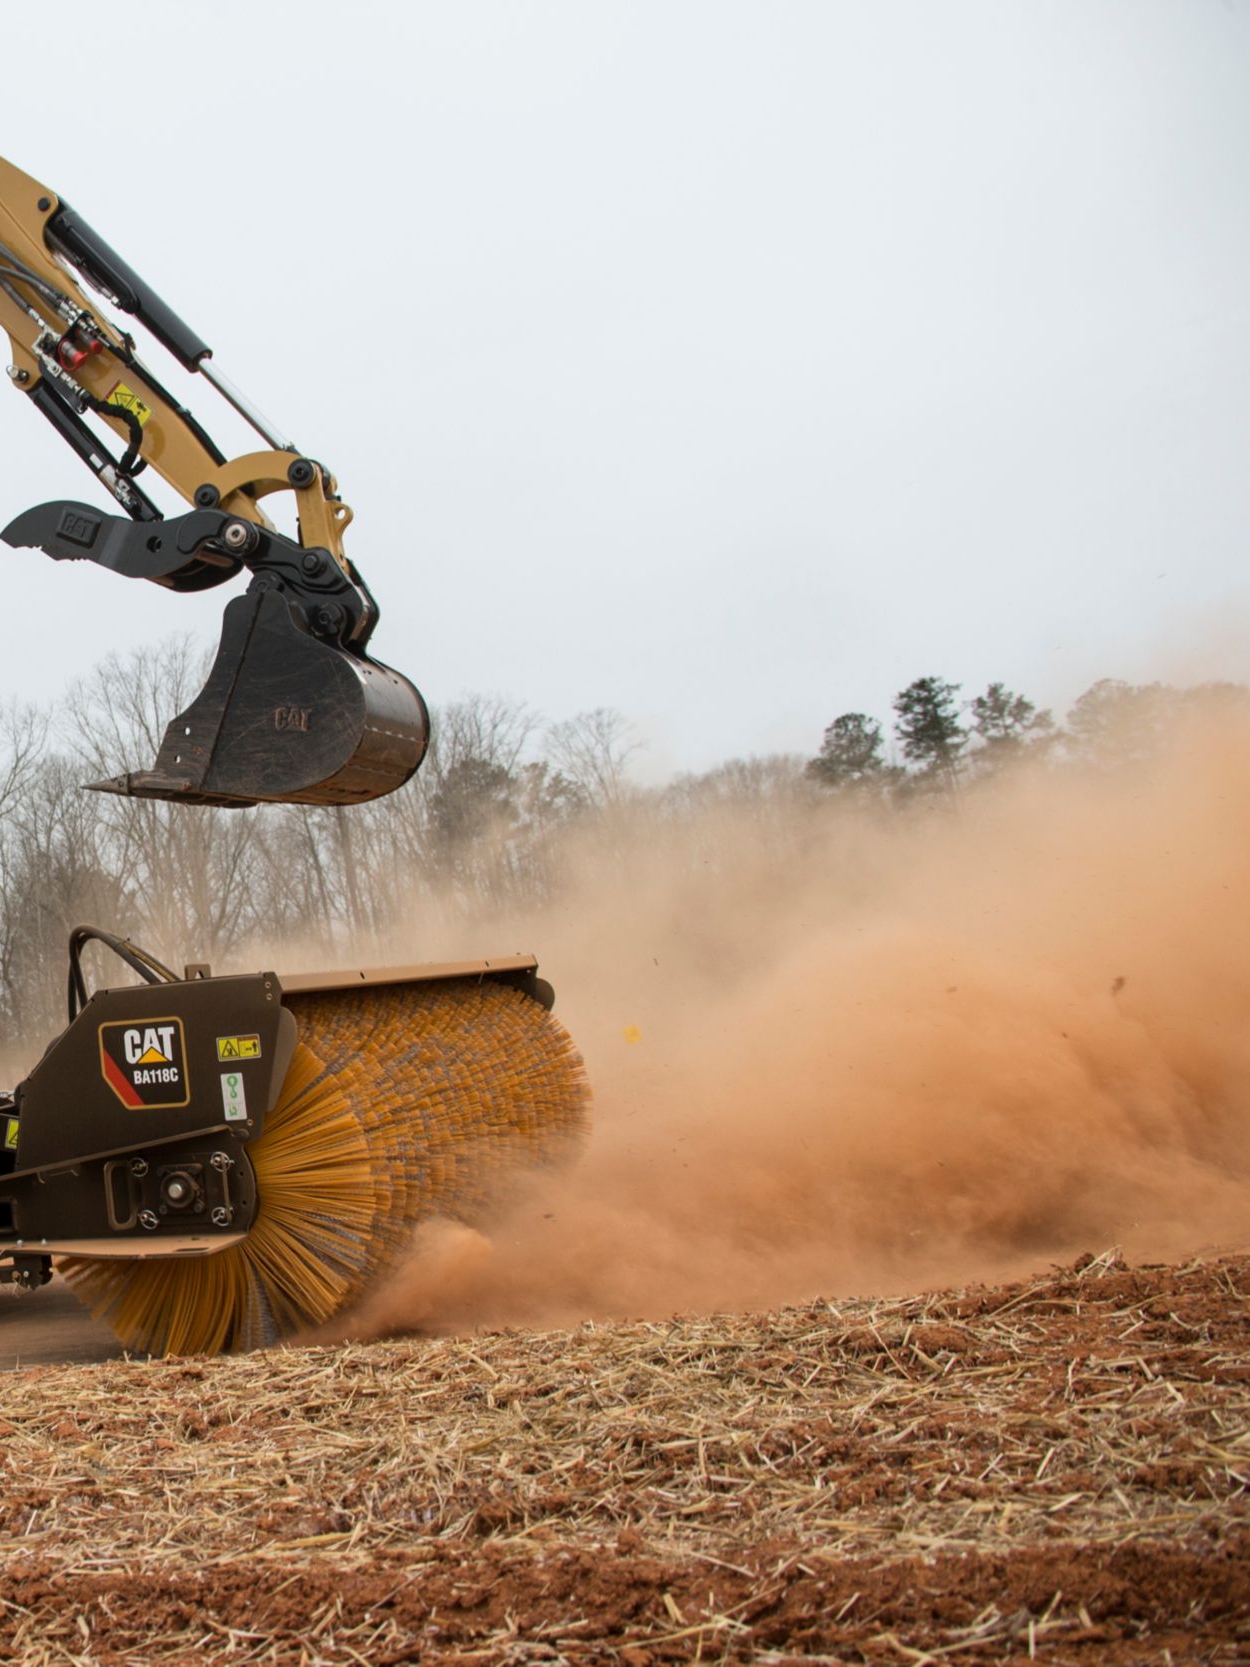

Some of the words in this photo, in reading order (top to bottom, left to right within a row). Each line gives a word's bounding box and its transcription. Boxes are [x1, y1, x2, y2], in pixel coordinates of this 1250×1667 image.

[275, 704, 312, 732] CAT
[124, 1026, 175, 1064] CAT
[133, 1067, 179, 1085] BA118C
